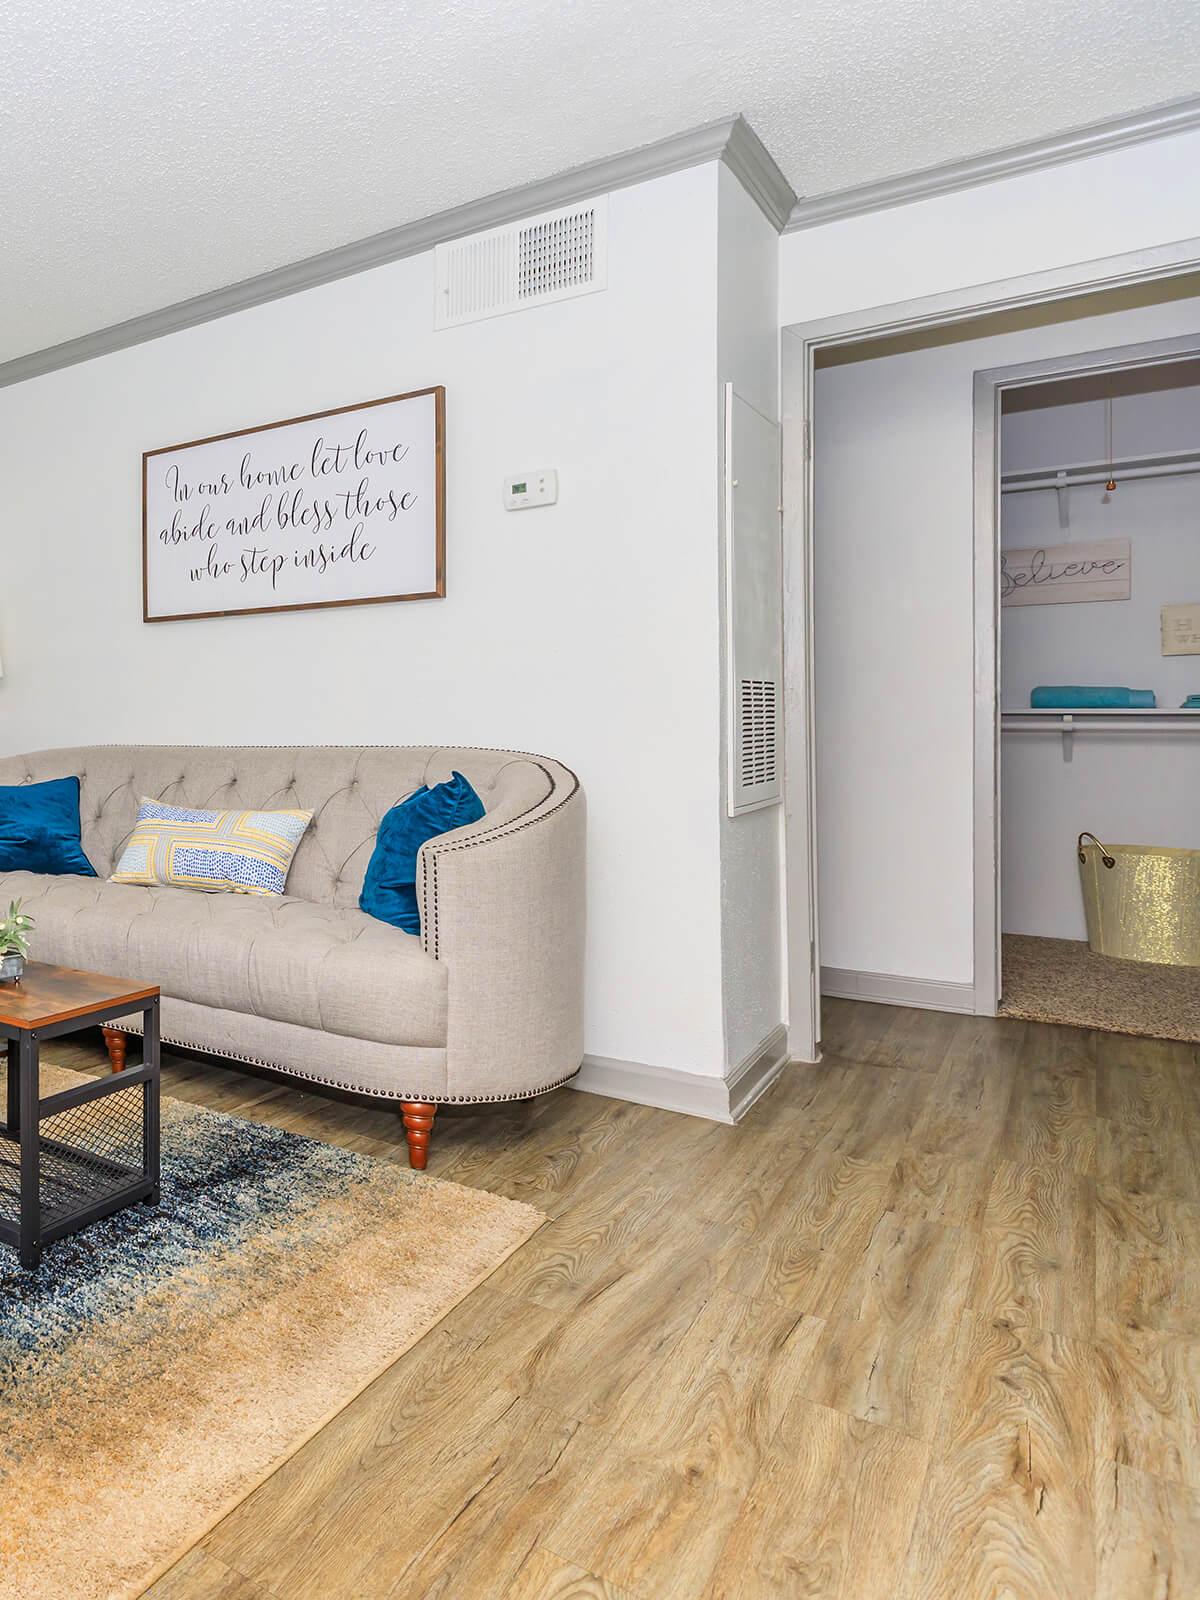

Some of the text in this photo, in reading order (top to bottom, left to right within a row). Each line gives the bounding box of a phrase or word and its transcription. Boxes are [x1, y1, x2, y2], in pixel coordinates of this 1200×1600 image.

[165, 428, 410, 503] In our home let love
[159, 476, 418, 546] abide and bless those
[190, 521, 376, 591] who step inside
